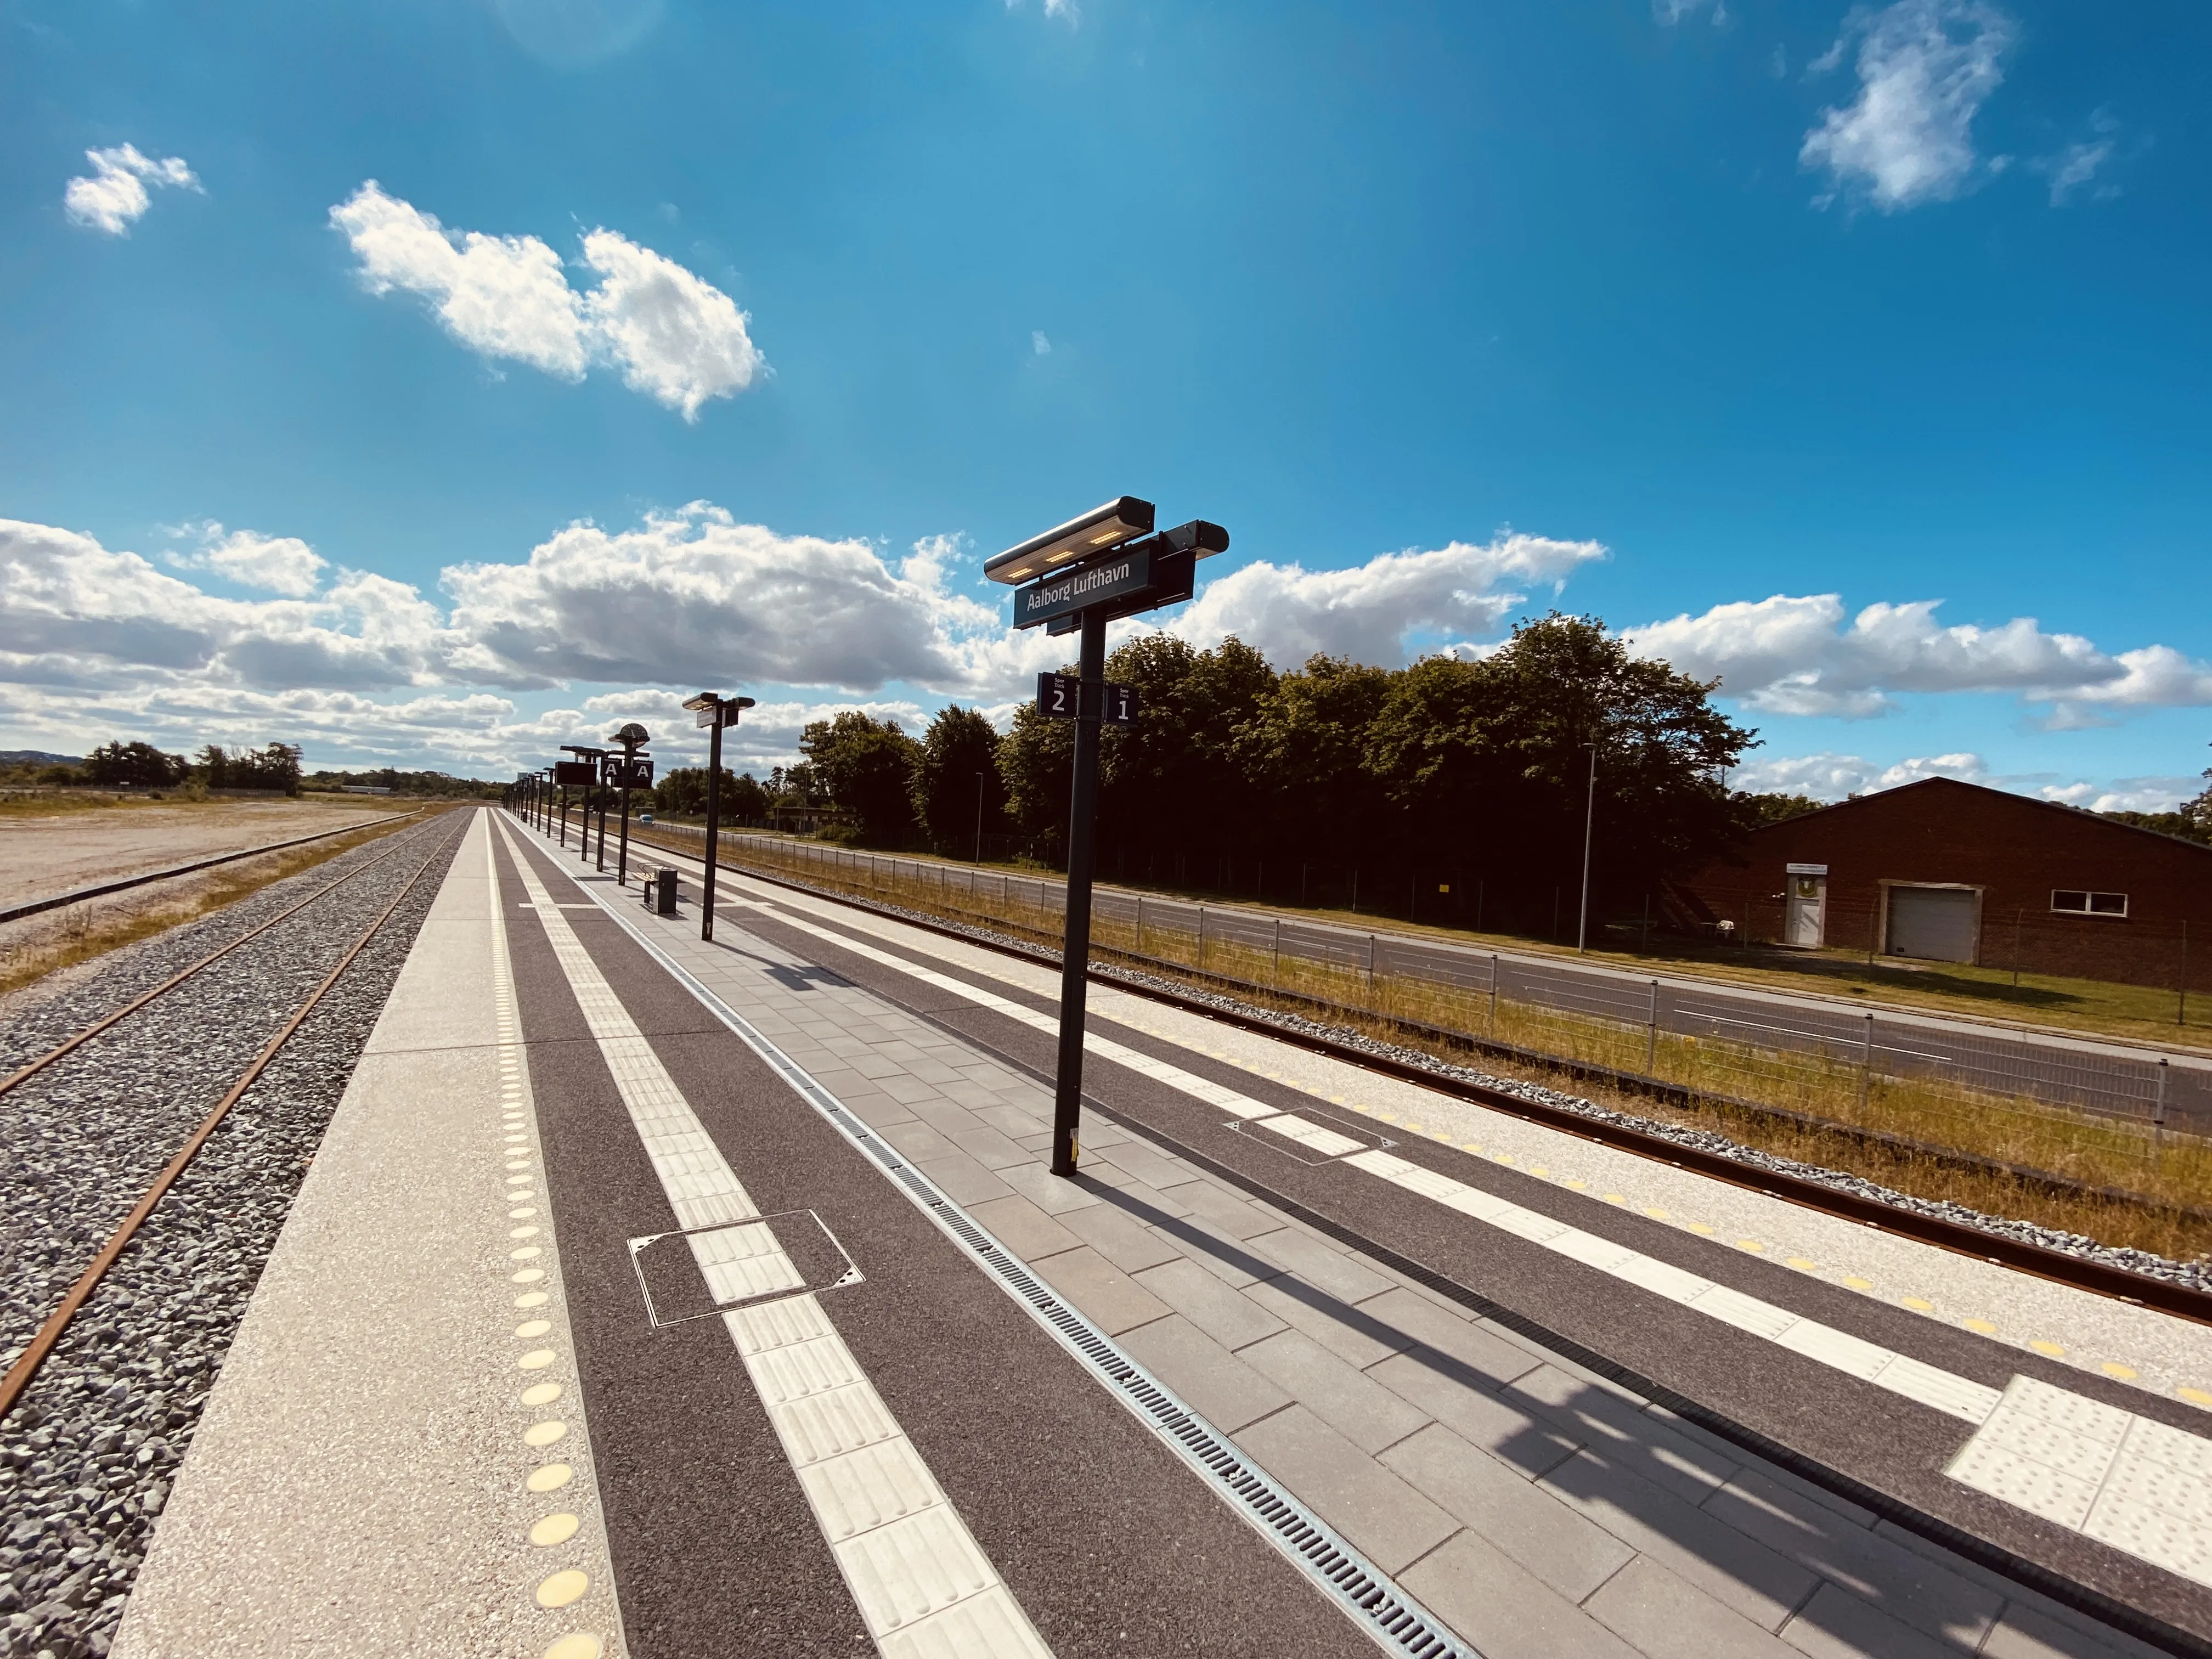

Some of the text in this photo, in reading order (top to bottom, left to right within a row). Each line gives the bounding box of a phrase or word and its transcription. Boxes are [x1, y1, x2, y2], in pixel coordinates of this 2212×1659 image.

[1027, 563, 1130, 612] Aalborg Lufthavn
[1052, 690, 1065, 712] 2
[1118, 701, 1128, 720] 1
[605, 763, 617, 775] A
[637, 765, 649, 777] A
